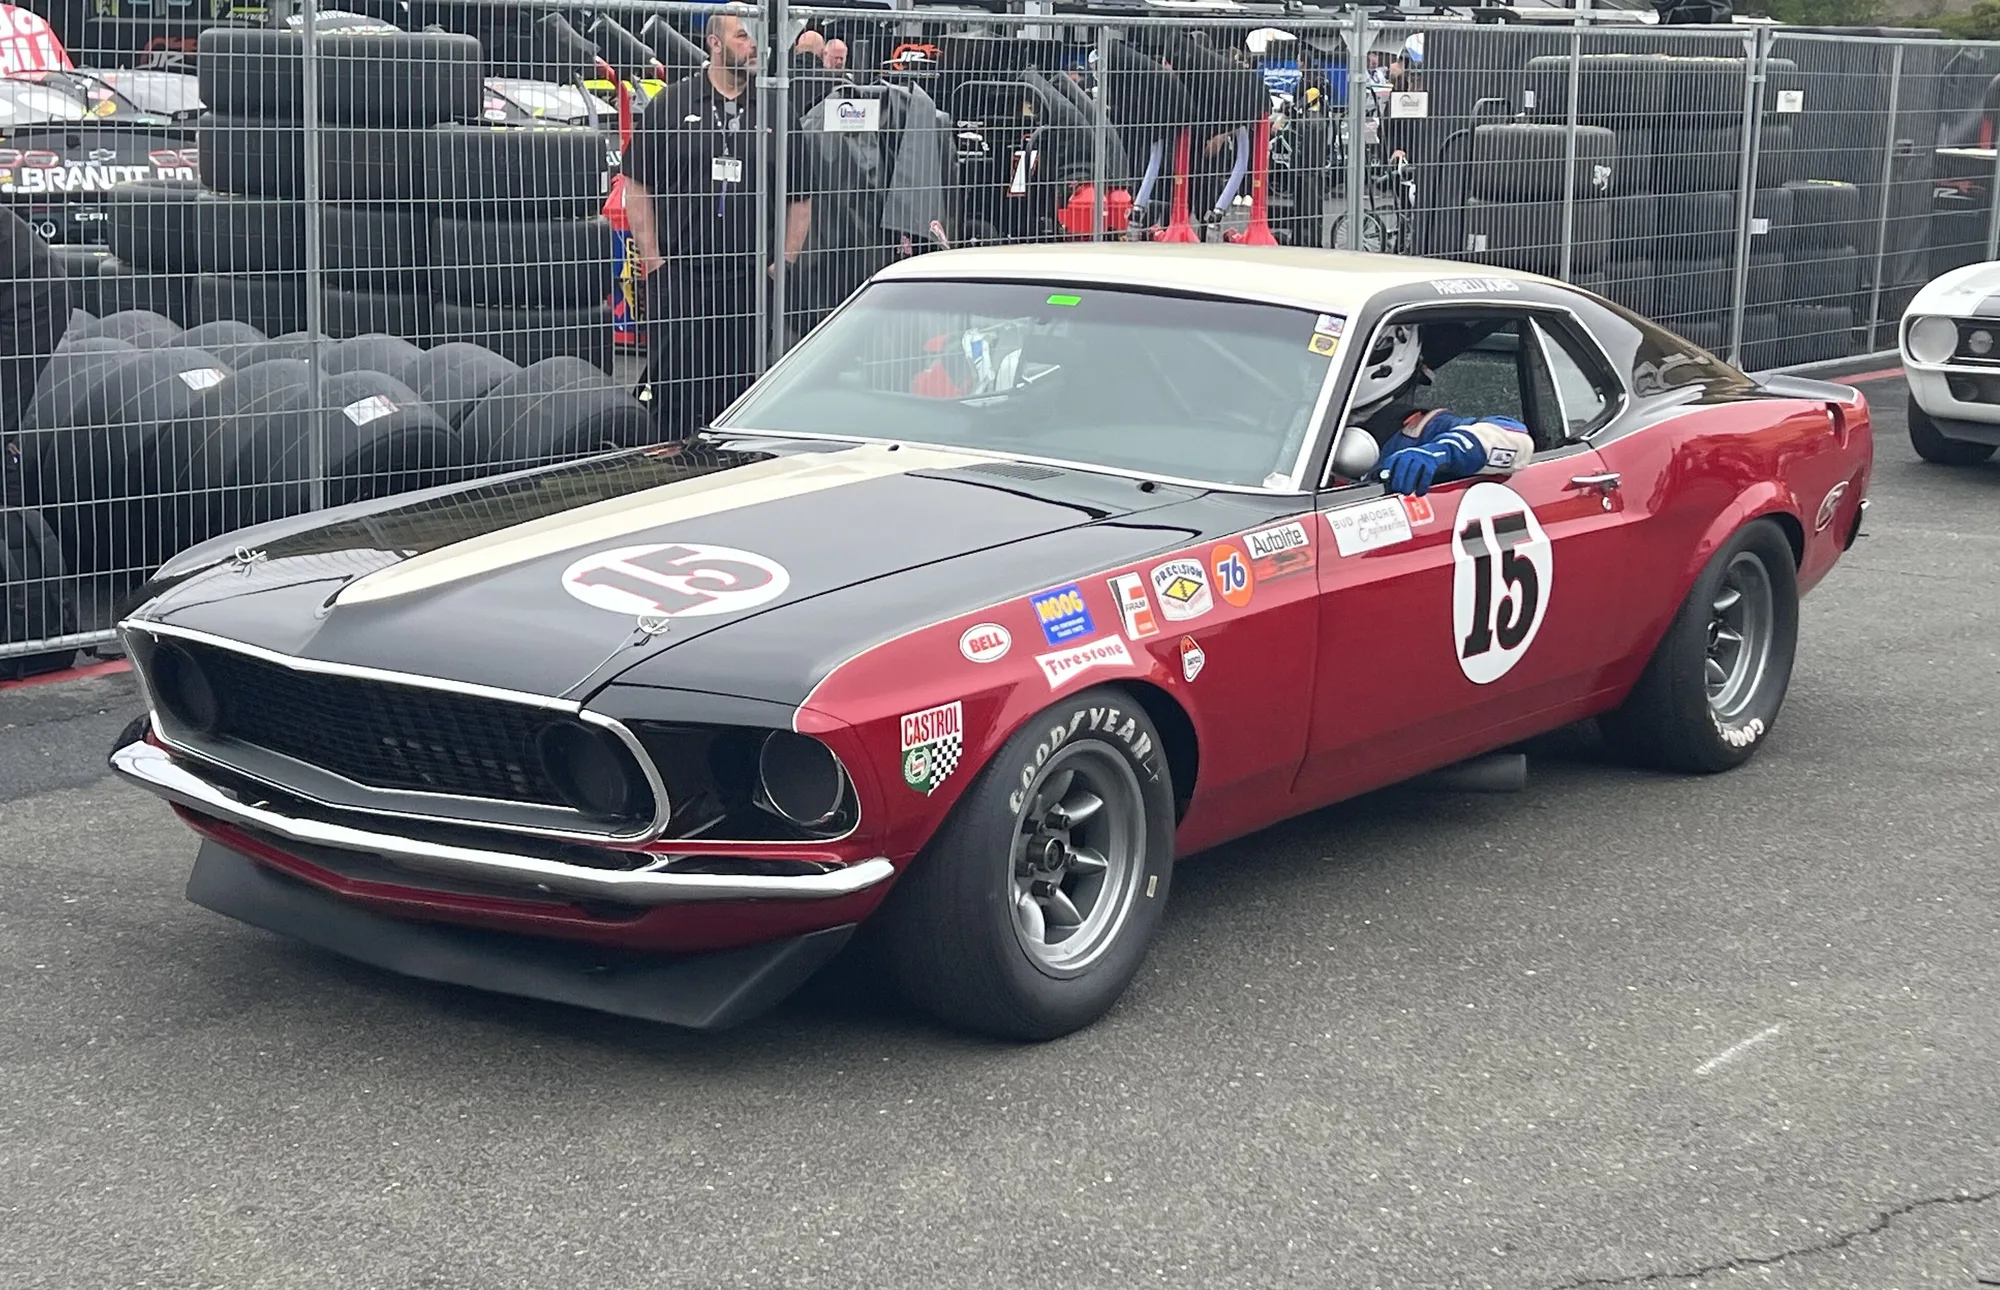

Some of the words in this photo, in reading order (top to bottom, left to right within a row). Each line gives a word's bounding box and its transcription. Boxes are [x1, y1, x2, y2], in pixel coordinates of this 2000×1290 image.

[1332, 516, 1354, 529] BUD
[1360, 507, 1397, 523] MOORE
[1251, 526, 1304, 556] Autolite
[571, 545, 773, 615] 15
[1154, 563, 1203, 588] PRECISION
[1218, 554, 1246, 593] 76
[1459, 510, 1540, 660] 15
[1035, 589, 1085, 624] MOOG
[1124, 599, 1146, 613] FRAM
[968, 631, 1005, 654] BELL
[1045, 643, 1124, 677] Firestone
[904, 705, 960, 747] CASTROL
